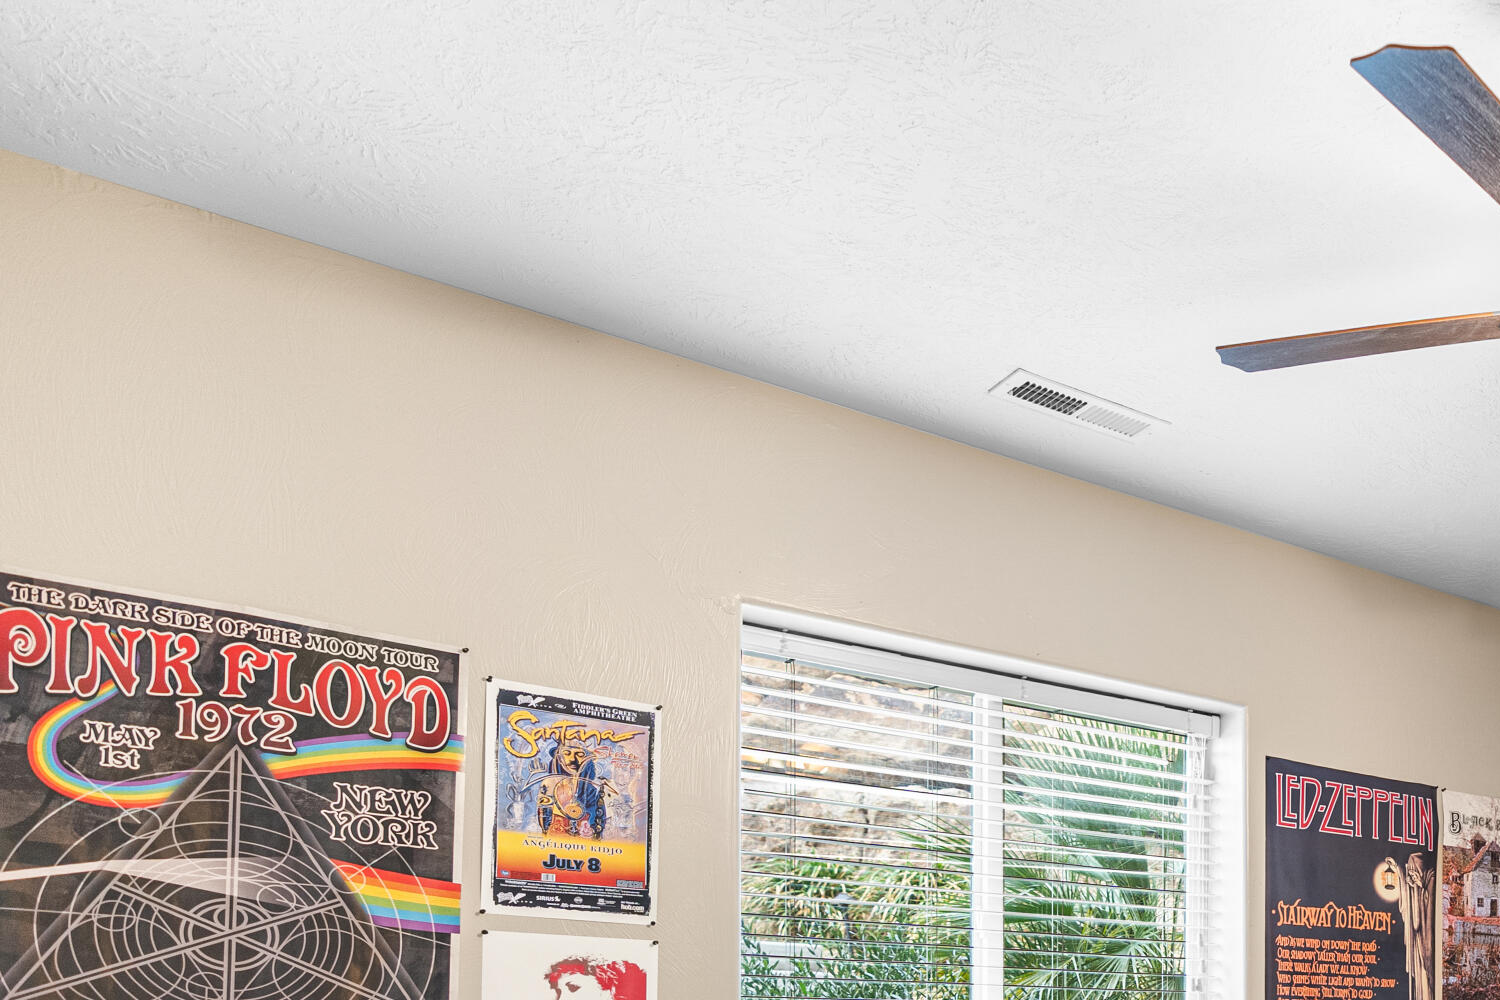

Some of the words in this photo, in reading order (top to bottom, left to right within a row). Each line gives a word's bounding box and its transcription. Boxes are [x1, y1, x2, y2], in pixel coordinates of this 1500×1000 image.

[7, 581, 65, 609] THE
[70, 593, 149, 622] DARK
[153, 606, 213, 633] SIDE
[216, 617, 253, 639] OF
[253, 623, 302, 648] THE
[306, 633, 378, 662] MOON
[381, 647, 439, 673] TOUR
[0, 606, 202, 698] PINK
[219, 642, 451, 750] FLOYD
[175, 698, 297, 753] 1972
[572, 702, 611, 714] FIDDLER'S
[612, 708, 638, 718] GREEN
[574, 708, 636, 722] AMPHITHEATRE
[79, 719, 161, 751] MAY
[504, 711, 645, 758] Santana
[99, 746, 141, 770] 1st
[330, 781, 431, 820] NEW
[320, 809, 439, 850] YORK
[542, 854, 584, 872] JULY
[588, 858, 601, 873] 8
[1277, 898, 1335, 928] STAIRWAY
[1334, 906, 1347, 928] TO
[1347, 904, 1391, 934] HEAVEN
